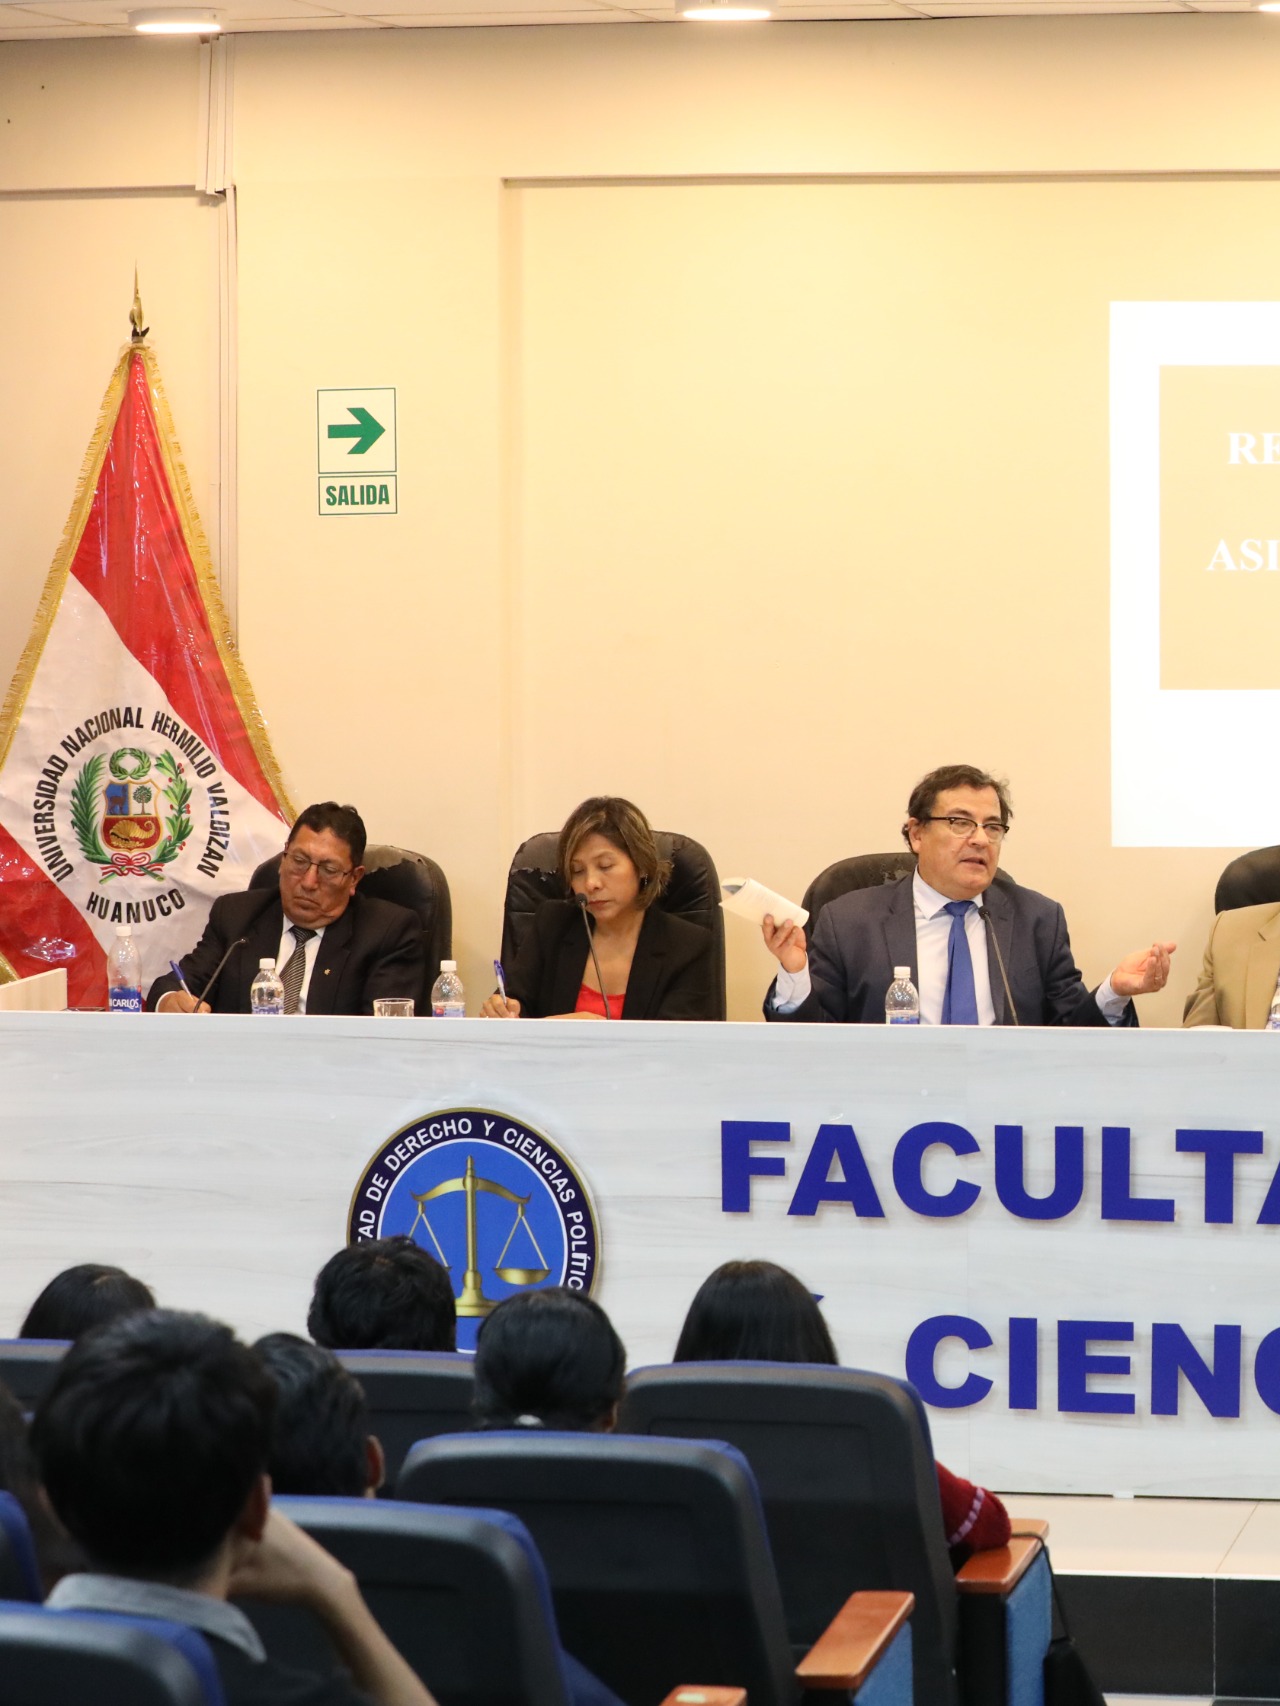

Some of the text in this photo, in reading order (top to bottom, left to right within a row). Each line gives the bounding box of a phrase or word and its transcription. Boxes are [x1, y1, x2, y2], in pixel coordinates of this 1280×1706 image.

[325, 484, 390, 507] SALIDA
[33, 707, 231, 883] UNIVERSIDAD NACIONAL HERMILIO VALDIZAN
[86, 888, 186, 924] HUANUCO
[113, 998, 140, 1009] CARLOS
[366, 1117, 592, 1291] DE DERECHO Y CIENCIAS POLÍTIC
